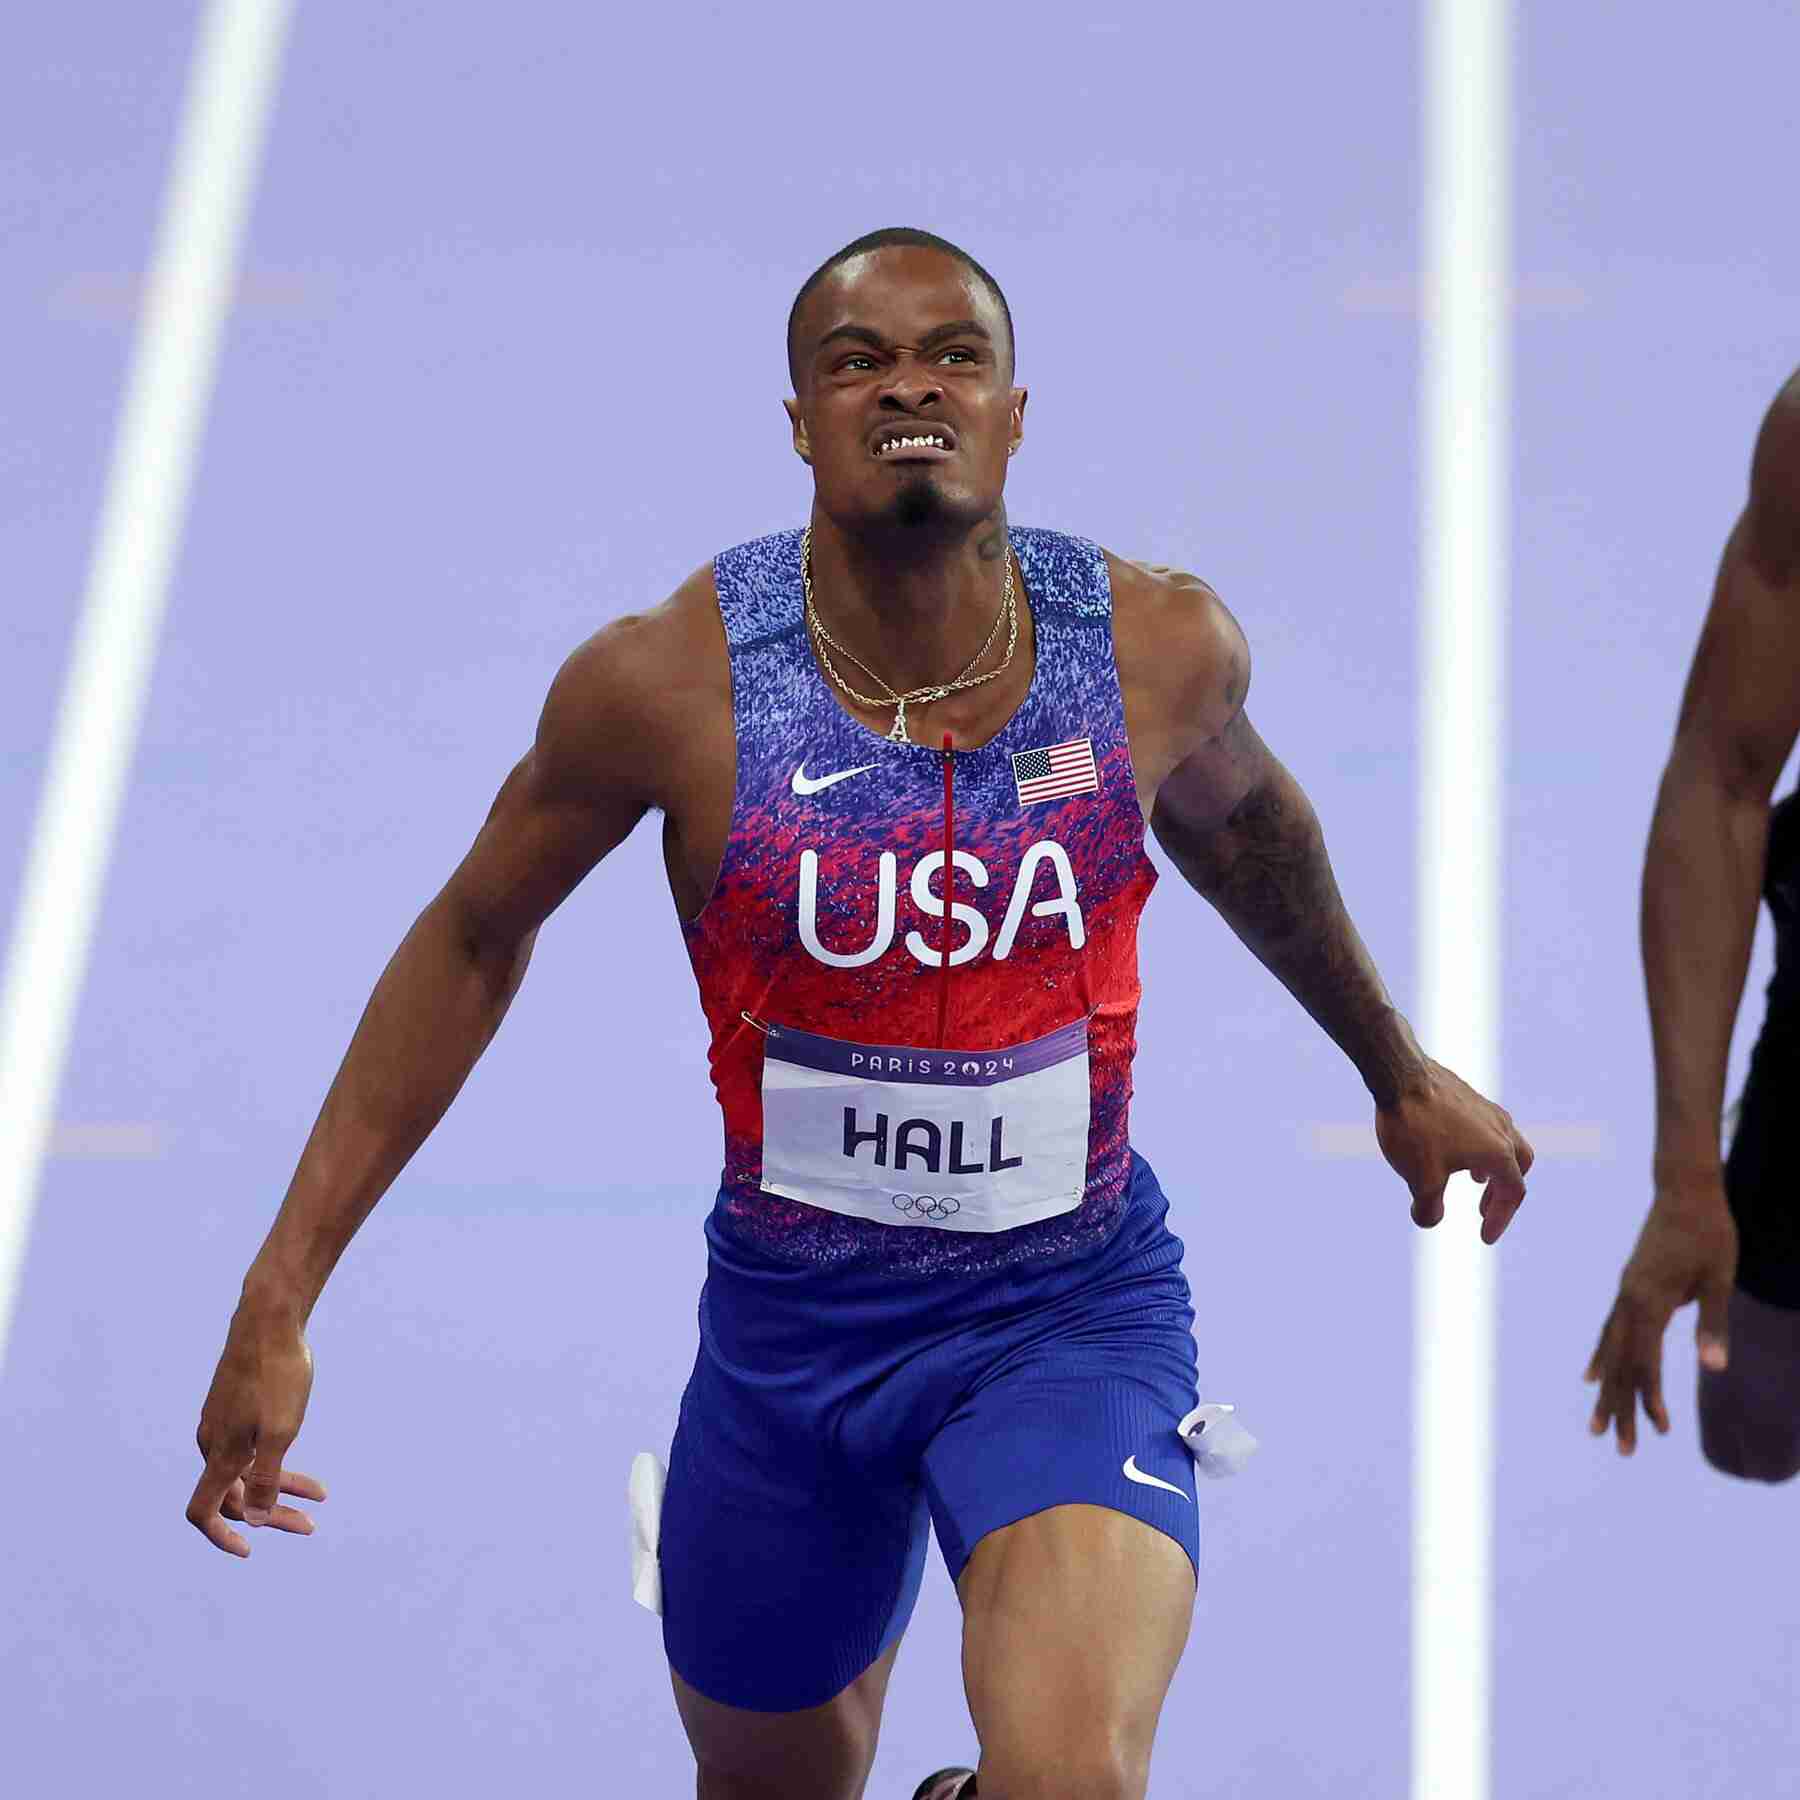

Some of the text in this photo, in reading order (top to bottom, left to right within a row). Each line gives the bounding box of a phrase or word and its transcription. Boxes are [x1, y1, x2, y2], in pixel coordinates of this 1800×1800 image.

[798, 840, 1085, 968] USA
[943, 1058, 1014, 1077] 2024
[843, 1106, 1023, 1174] HALL
